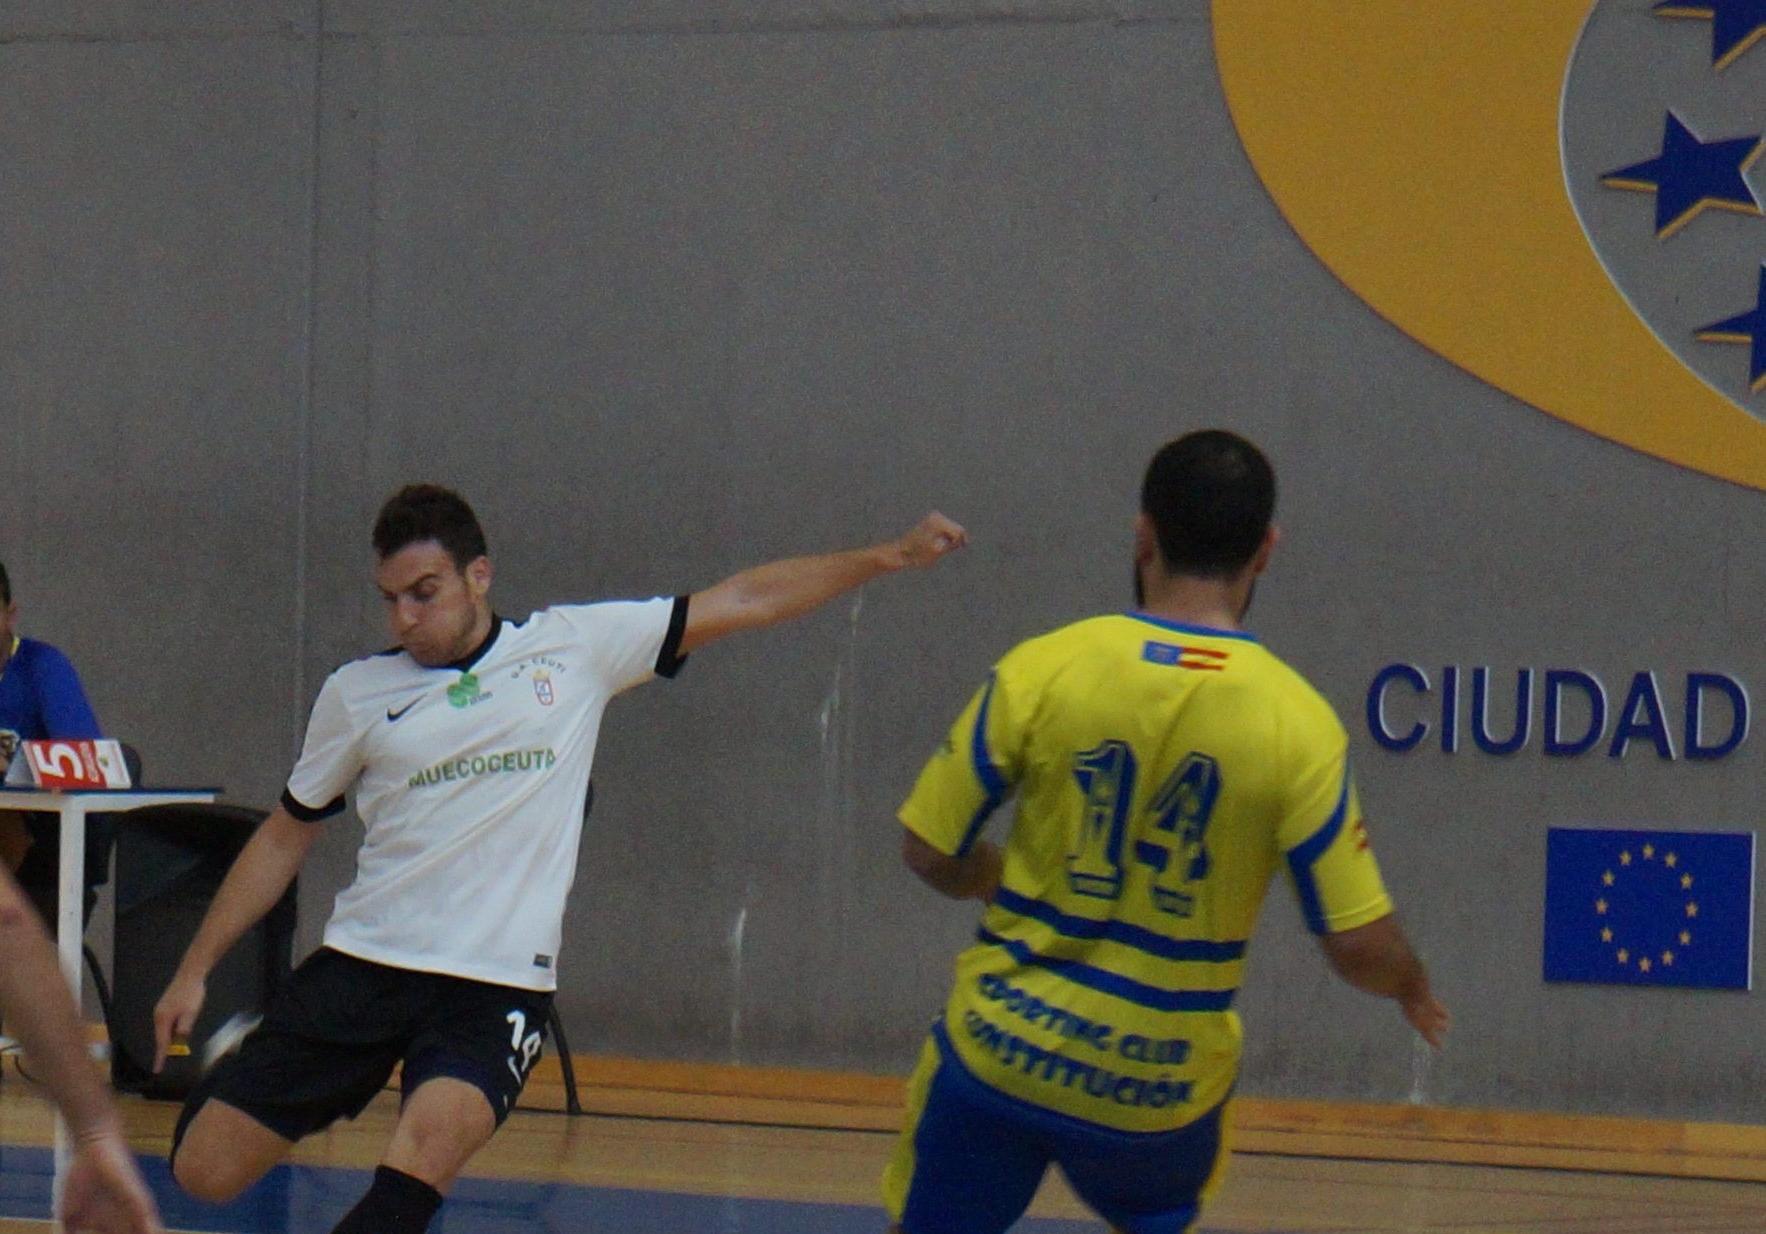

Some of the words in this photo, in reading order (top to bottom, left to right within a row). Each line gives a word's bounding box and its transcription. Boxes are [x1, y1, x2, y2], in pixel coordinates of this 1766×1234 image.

[1366, 662, 1751, 760] CIUDAD
[32, 742, 84, 780] 5
[1066, 739, 1223, 918] 14
